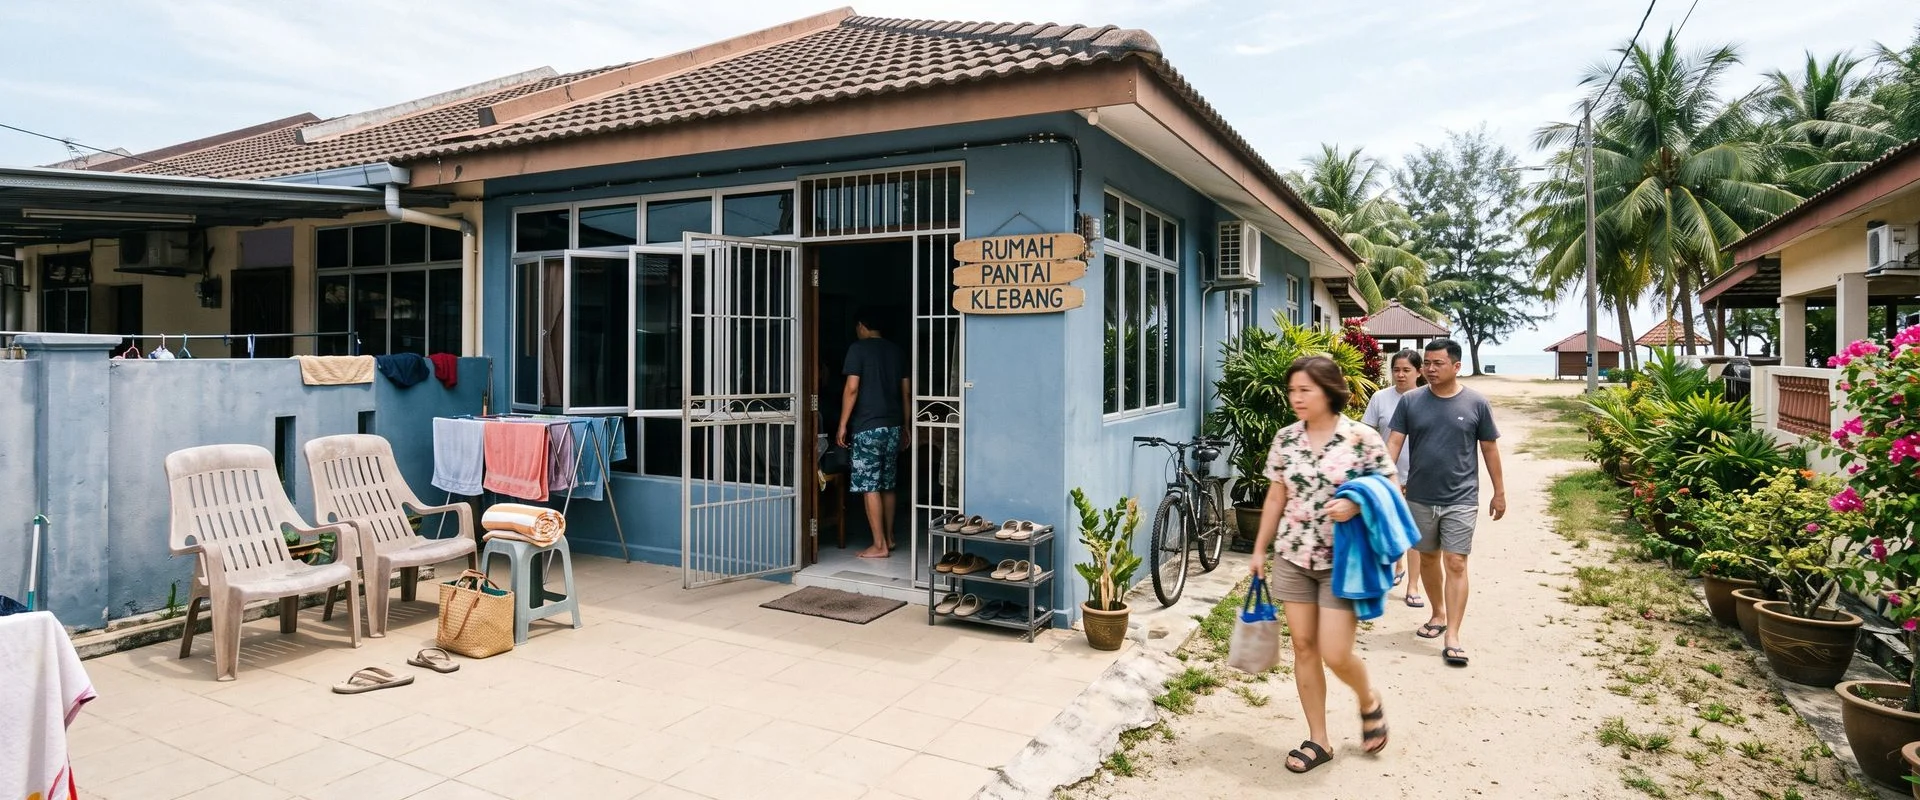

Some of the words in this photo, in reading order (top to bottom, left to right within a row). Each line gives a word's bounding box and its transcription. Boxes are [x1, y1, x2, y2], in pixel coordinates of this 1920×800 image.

[982, 237, 1053, 260] RUMAH
[982, 262, 1051, 284] PANTAI
[971, 288, 1063, 309] KLEBANG
